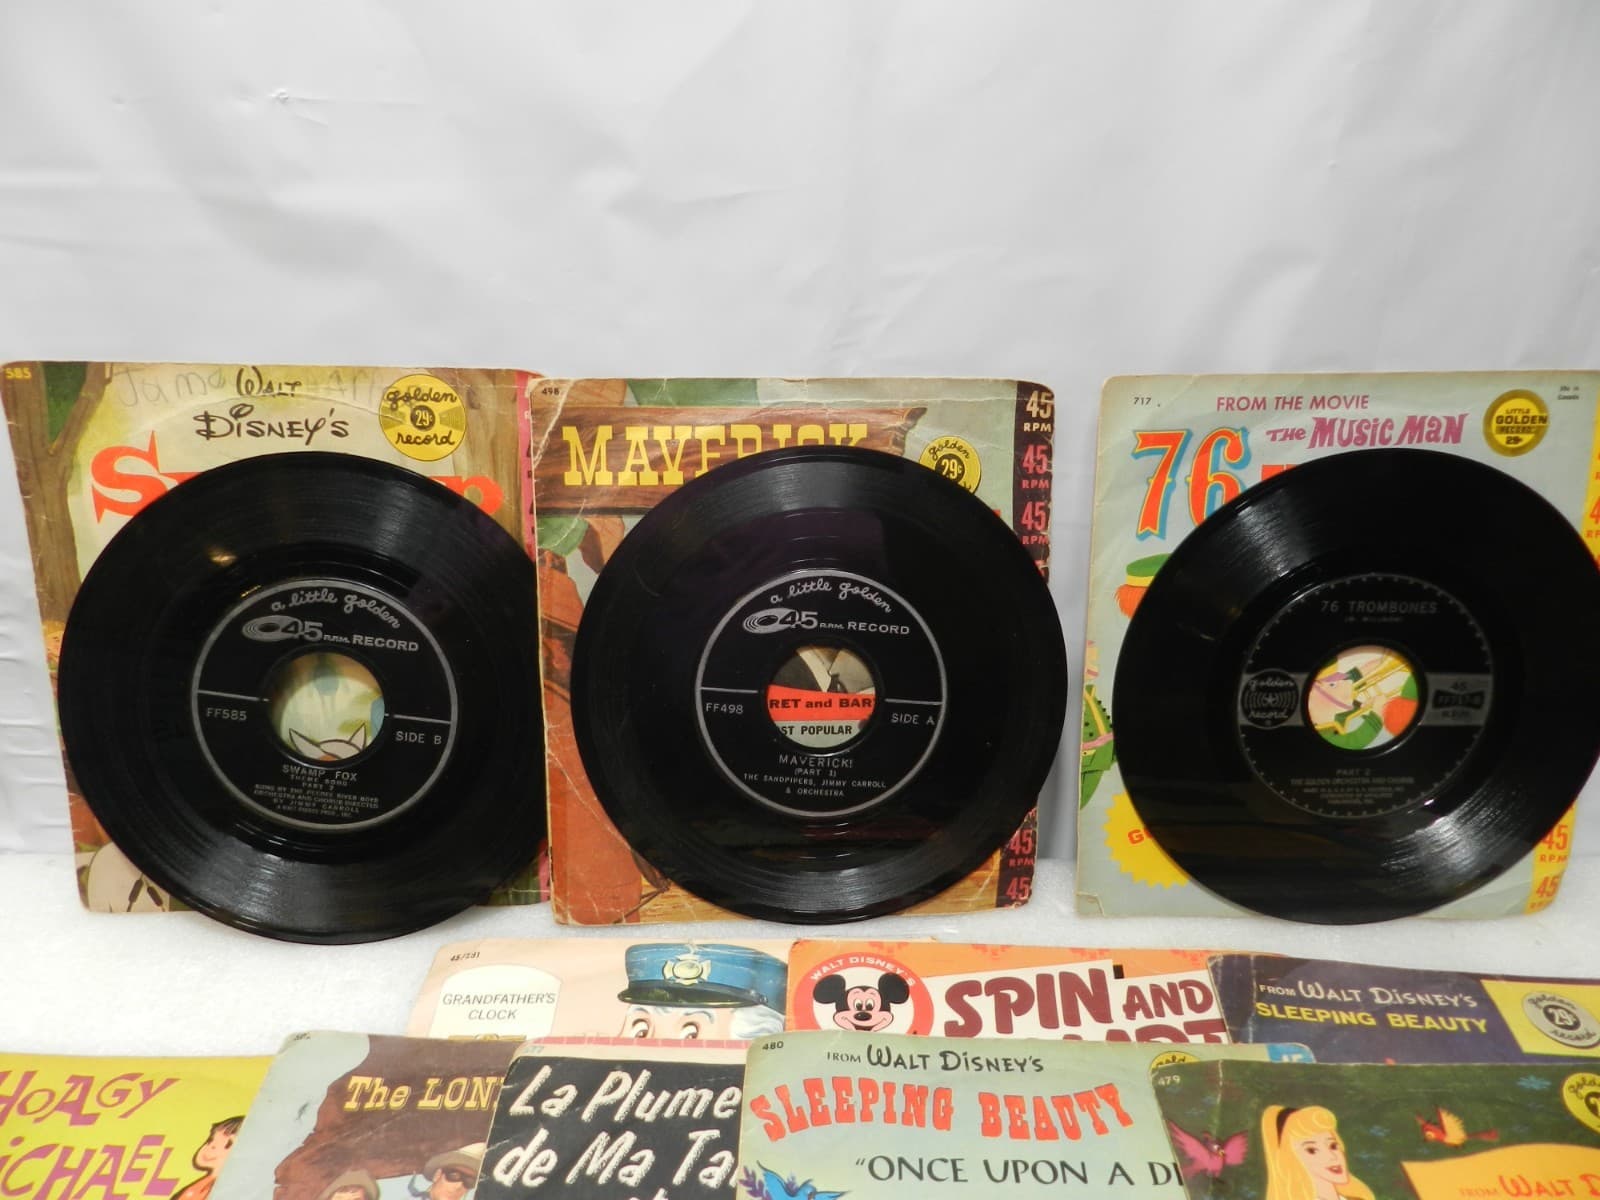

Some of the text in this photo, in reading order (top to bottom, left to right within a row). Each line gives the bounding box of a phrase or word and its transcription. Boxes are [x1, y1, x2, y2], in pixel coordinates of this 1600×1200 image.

[386, 387, 457, 412] golden
[541, 387, 560, 396] 498
[1026, 390, 1051, 419] 45
[1133, 396, 1152, 406] 717
[1216, 394, 1370, 412] FROM THE MOVIE
[1023, 422, 1051, 432] RPM
[1495, 415, 1548, 425] GOLDEN
[395, 430, 455, 446] record
[928, 439, 970, 461] golden
[1022, 444, 1047, 475] 45
[1022, 479, 1049, 489] RPM
[1131, 427, 1252, 542] 76
[1021, 501, 1046, 531] 45
[1022, 535, 1049, 545] RPM
[770, 578, 892, 613] a little golden
[271, 587, 401, 629] a little golden
[1320, 600, 1438, 615] 76 TROMBONES
[779, 611, 818, 630] 45
[847, 620, 910, 636] RECORD
[352, 634, 420, 652] RECORD
[705, 702, 744, 715] FF498
[805, 699, 833, 708] and
[206, 707, 249, 721] FF585
[891, 713, 936, 726] SIDE A
[395, 730, 443, 745] SIDE B
[800, 725, 852, 735] POPULAR
[282, 764, 359, 782] SWAMP FOX
[744, 772, 759, 781] THE
[821, 779, 848, 787] JIMMY
[851, 780, 887, 788] CARROLL
[794, 767, 822, 776] (PART
[302, 782, 324, 790] PART
[797, 787, 845, 797] ORCHESTRA
[1010, 829, 1034, 855] 45
[1542, 824, 1569, 851] 45
[1540, 854, 1568, 864] RPM
[1006, 877, 1031, 901] 45
[1536, 876, 1561, 899] 45
[811, 956, 916, 987] WALT DISNEY'S
[443, 992, 556, 1006] GRANDFATHER'S
[1259, 984, 1297, 997] FROM
[944, 968, 1214, 1039] SPIN AND
[468, 1008, 519, 1021] CLOCK
[1255, 1001, 1488, 1034] SLEEPING BEAUTY
[762, 1040, 784, 1051] 480
[1158, 1074, 1180, 1086] 479
[343, 1075, 412, 1111] The
[509, 1064, 743, 1123] La Plume
[750, 1076, 1135, 1143] SLEEPING BEAUTY
[493, 1127, 558, 1188] de
[565, 1130, 656, 1188] Ma
[982, 1158, 1090, 1185] UPON
[1107, 1161, 1135, 1186] A
